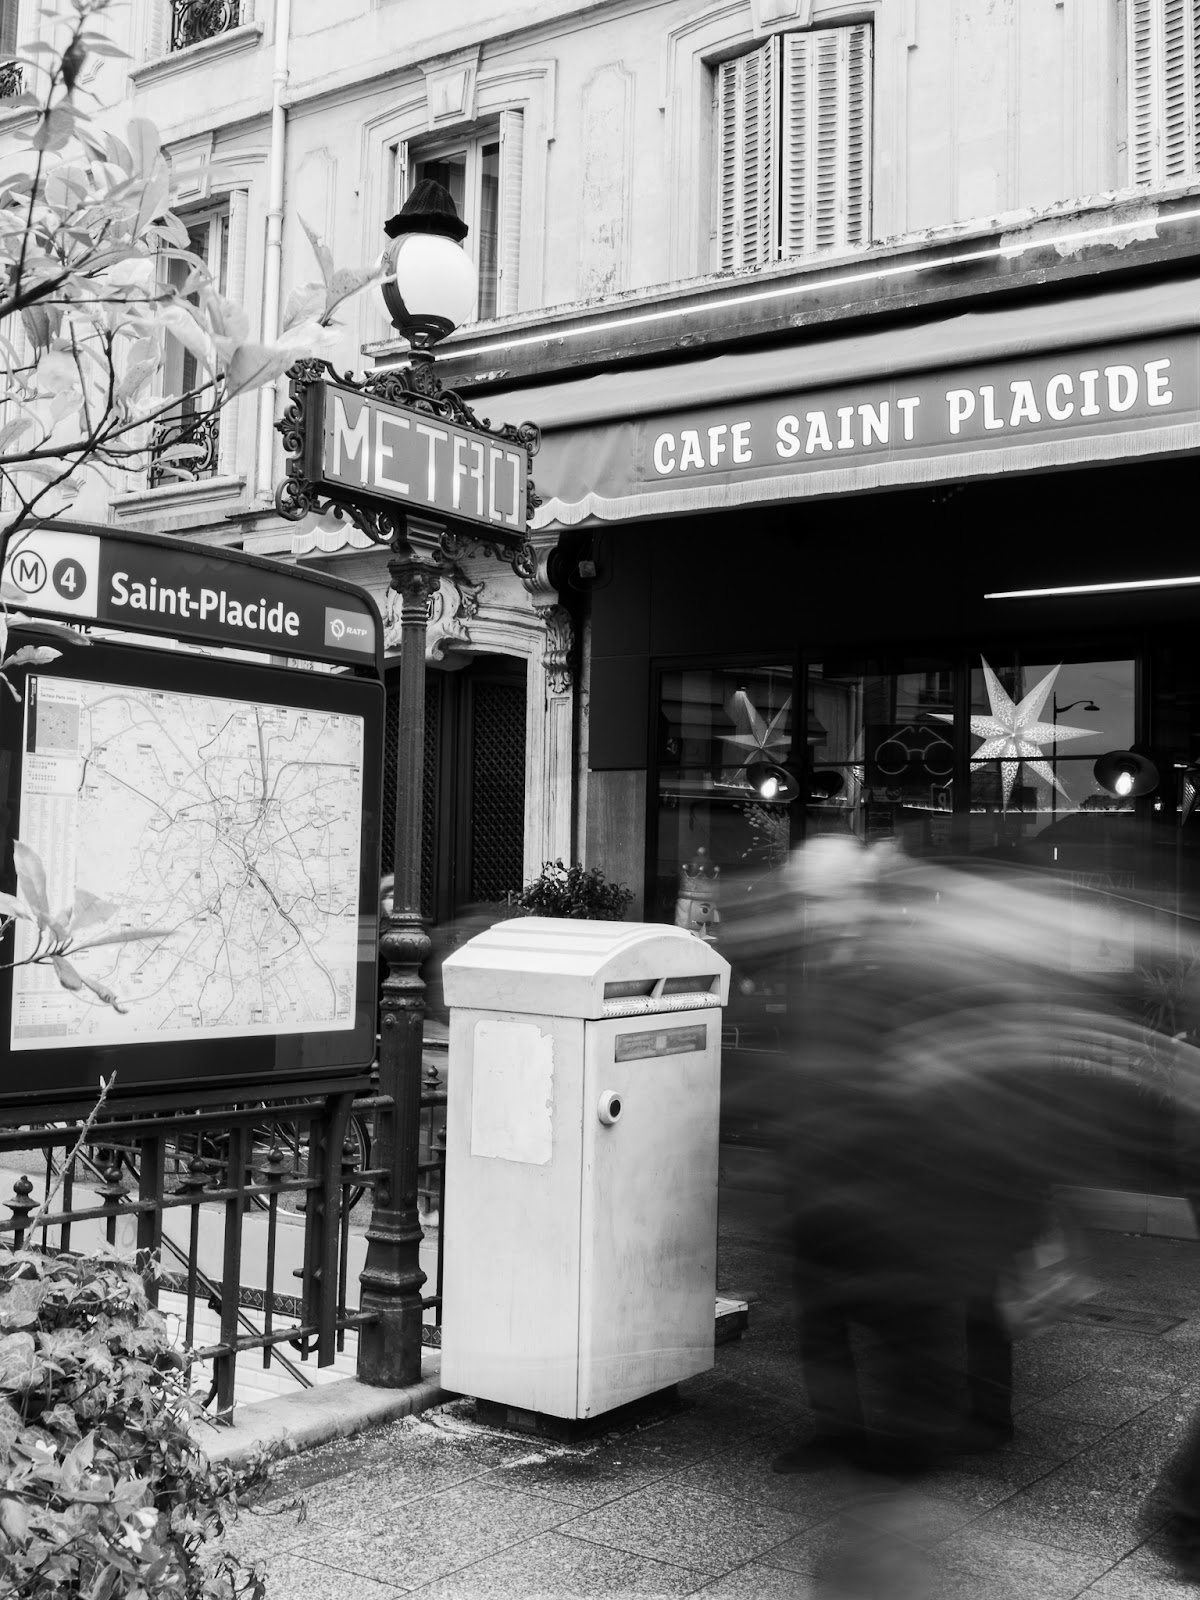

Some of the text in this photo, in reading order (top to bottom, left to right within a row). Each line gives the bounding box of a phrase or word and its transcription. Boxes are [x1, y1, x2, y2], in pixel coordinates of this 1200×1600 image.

[332, 395, 521, 526] METRO
[653, 359, 1173, 474] CAFE SAINT PLACIDE
[60, 566, 77, 593] 4
[110, 571, 300, 636] Saint-Placide
[346, 626, 368, 637] RATP
